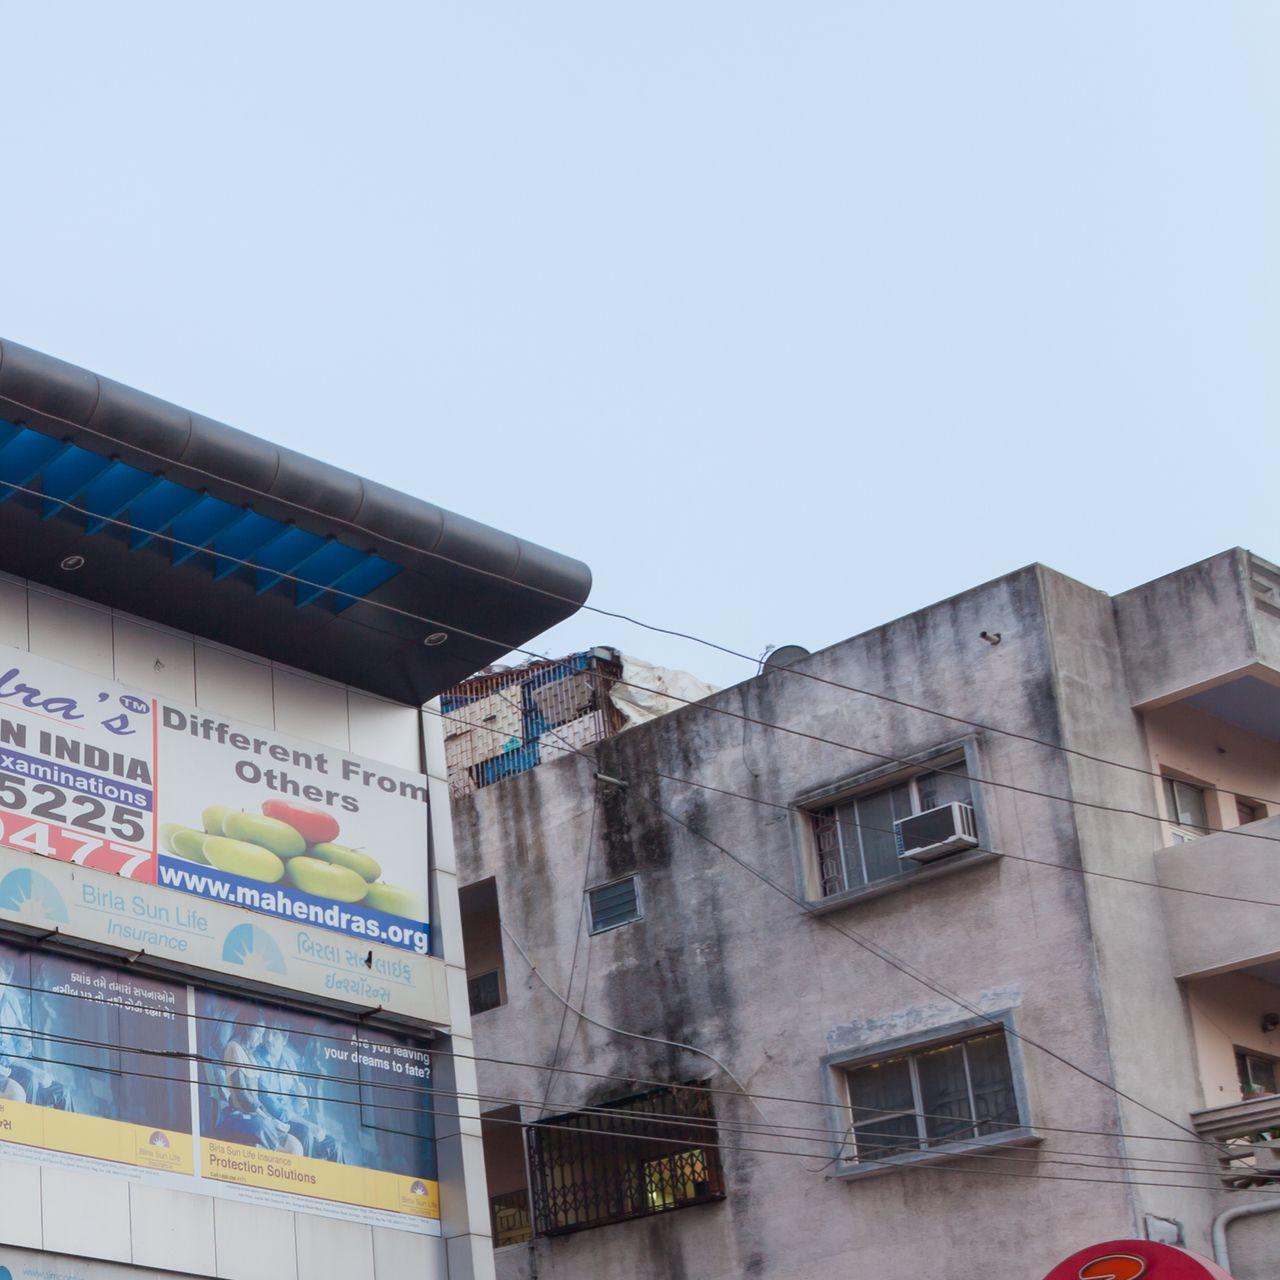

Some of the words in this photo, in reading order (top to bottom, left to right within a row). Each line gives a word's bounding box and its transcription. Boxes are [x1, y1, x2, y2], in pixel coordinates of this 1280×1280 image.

[40, 731, 152, 786] INDIA
[162, 706, 329, 774] Different
[341, 763, 429, 803] From
[236, 760, 360, 814] Others
[82, 883, 126, 914] Birla
[132, 896, 172, 924] Sun
[176, 906, 208, 932] Life
[160, 864, 429, 955] www.mahendras.org
[107, 918, 189, 952] Insurance
[324, 1047, 348, 1060] your
[351, 1051, 390, 1069] dreams
[392, 1061, 403, 1073] to
[405, 1063, 430, 1079] fate?
[209, 1155, 264, 1175] Protection
[267, 1167, 316, 1185] Solutions
